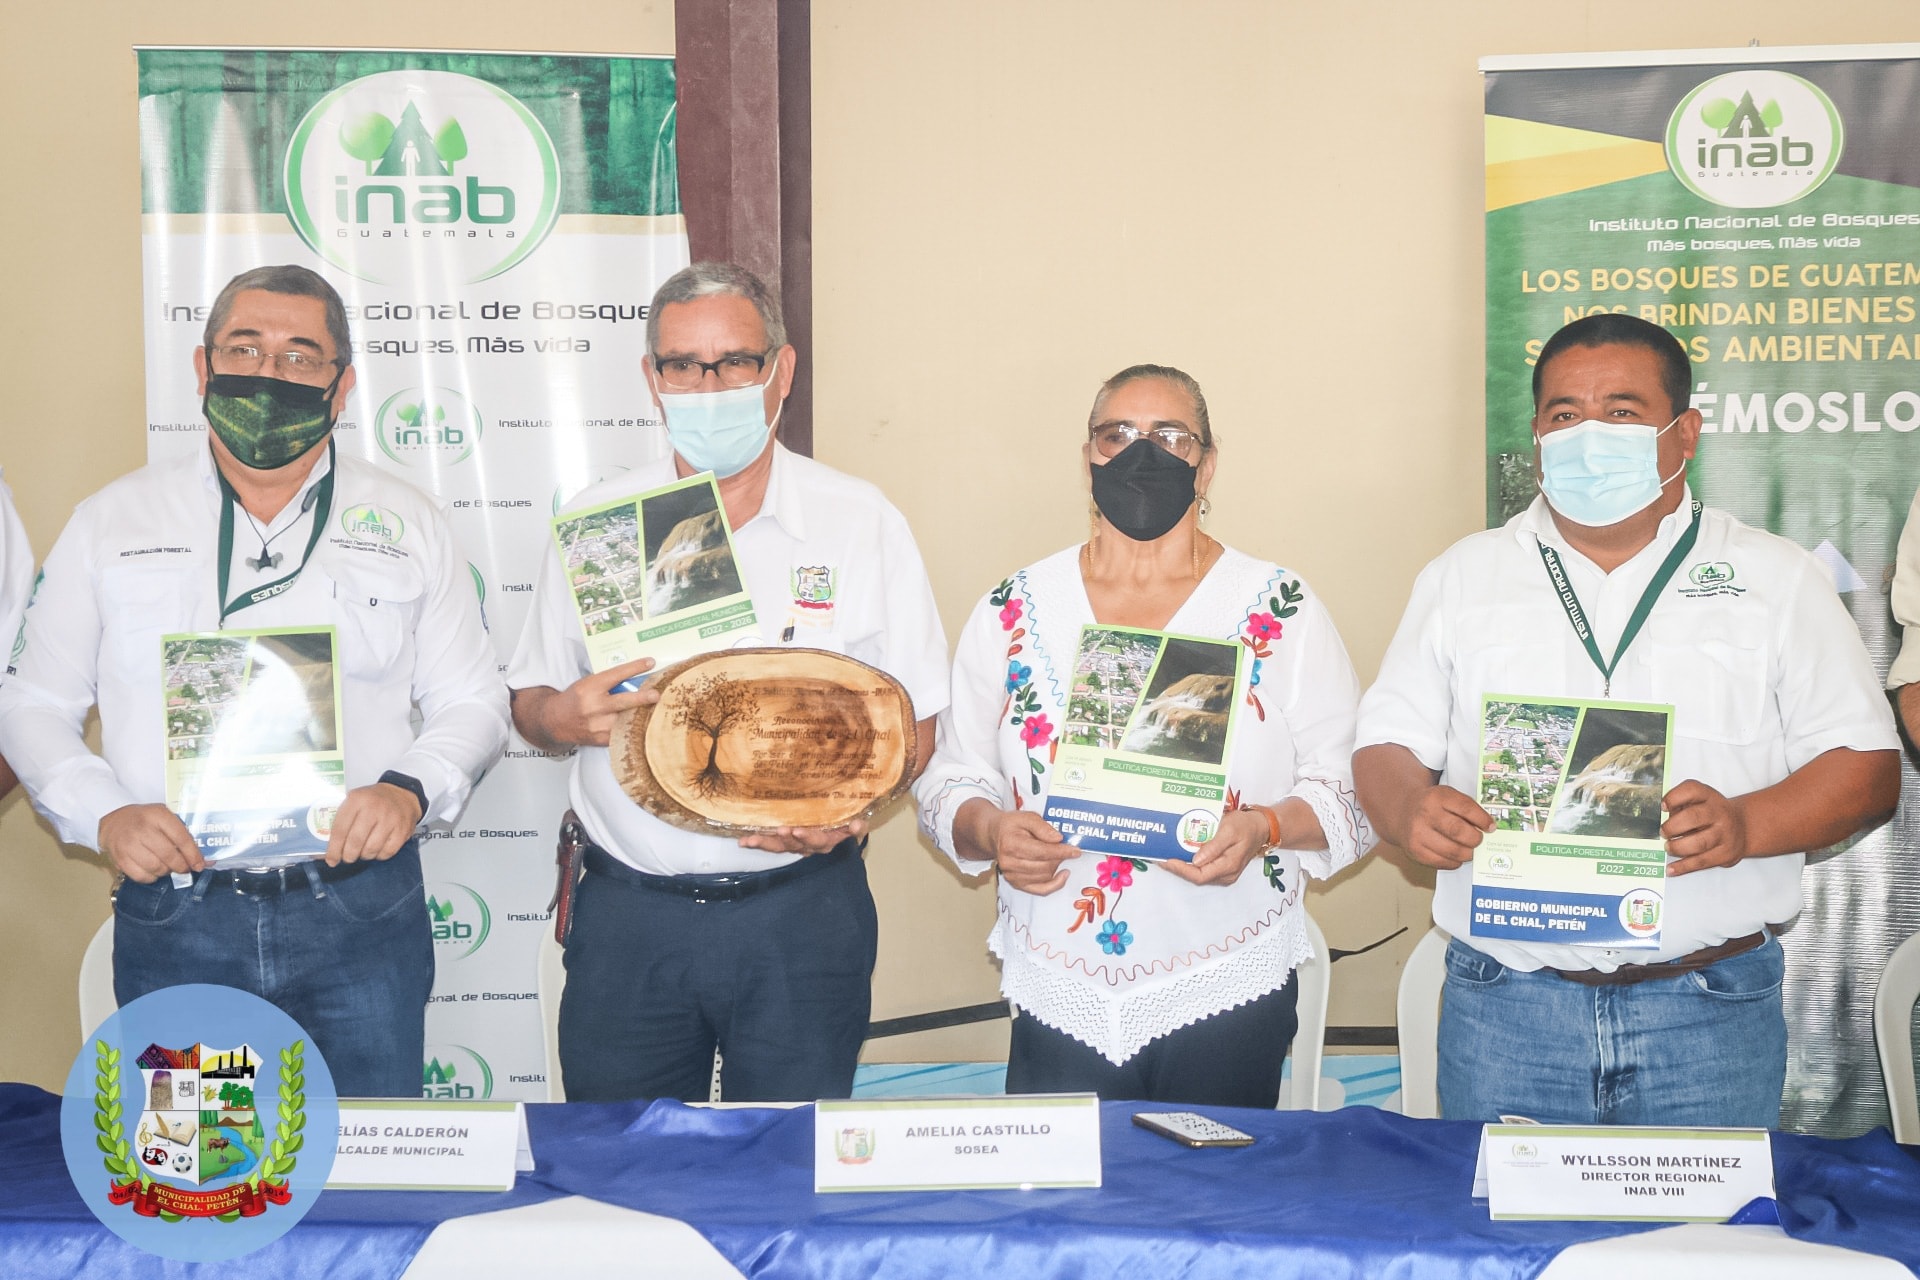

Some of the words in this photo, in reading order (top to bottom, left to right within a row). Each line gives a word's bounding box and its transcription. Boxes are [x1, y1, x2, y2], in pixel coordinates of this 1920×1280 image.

[1697, 136, 1814, 169] inab
[1697, 169, 1814, 177] Guatemala
[335, 175, 516, 224] inab
[1589, 218, 1679, 232] Instituto
[1684, 215, 1782, 230] Nacional
[1788, 214, 1816, 228] de
[1822, 213, 1920, 228] Bosques
[337, 228, 515, 239] Guatemala
[1647, 239, 1686, 252] Más
[1690, 238, 1775, 252] bosques,
[1779, 236, 1818, 250] Más
[1823, 236, 1862, 249] vida
[1522, 270, 1580, 292] LOS
[1591, 265, 1739, 294] BOSQUES
[1750, 265, 1790, 288] DE
[347, 301, 471, 321] acional
[481, 301, 521, 321] de
[533, 301, 650, 323] Bosque
[1640, 302, 1776, 325] BRINDAN
[1787, 297, 1915, 324] BIENES
[350, 338, 459, 357] osques,
[467, 336, 525, 353] Más
[534, 336, 591, 353] vida
[1690, 383, 1920, 434] ÉMOSLO
[498, 418, 553, 428] Instituto
[618, 418, 634, 428] de
[395, 426, 464, 445] inab
[453, 498, 471, 508] de
[474, 498, 532, 511] Bosques
[701, 625, 723, 637] 2022
[730, 616, 752, 628] 2026
[1141, 766, 1179, 777] FORESTAL
[1180, 771, 1219, 784] MUNICIPAL
[1164, 784, 1187, 794] 2022
[1194, 787, 1217, 798] 2026
[1047, 807, 1105, 824] GOBIERNO
[1106, 815, 1167, 834] MUNICIPAL
[459, 830, 476, 838] de
[480, 829, 539, 839] Bosques
[1062, 823, 1075, 834] EL
[1077, 825, 1109, 841] CHAL,
[1111, 830, 1146, 845] PETÉN
[1573, 848, 1615, 858] FORESTAL
[1616, 850, 1659, 860] MUNICIPAL
[1600, 864, 1624, 874] 2022
[1633, 866, 1658, 875] 2026
[1475, 898, 1538, 914] GOBIERNO
[1540, 903, 1608, 918] MUNICIPAL
[1475, 912, 1491, 924] DE
[1493, 914, 1508, 925] EL
[1510, 915, 1546, 930] CHAL,
[1548, 917, 1586, 931] PETÉN
[433, 921, 473, 939] ab
[461, 993, 479, 1001] de
[423, 1083, 475, 1099] nab
[336, 1124, 378, 1137] ELÍAS
[384, 1125, 469, 1138] CALDERÓN
[905, 1125, 967, 1138] AMELIA
[972, 1123, 1051, 1136] CASTILLO
[392, 1146, 465, 1157] MUNICIPAL
[954, 1145, 999, 1155] SOSEA
[1561, 1154, 1651, 1167] WYLLSSON
[1656, 1153, 1742, 1169] MARTÍNEZ
[1581, 1172, 1650, 1182] DIRECTOR
[1655, 1172, 1726, 1183] REGIONAL
[1624, 1186, 1657, 1196] INAB
[1662, 1186, 1685, 1197] VIII
